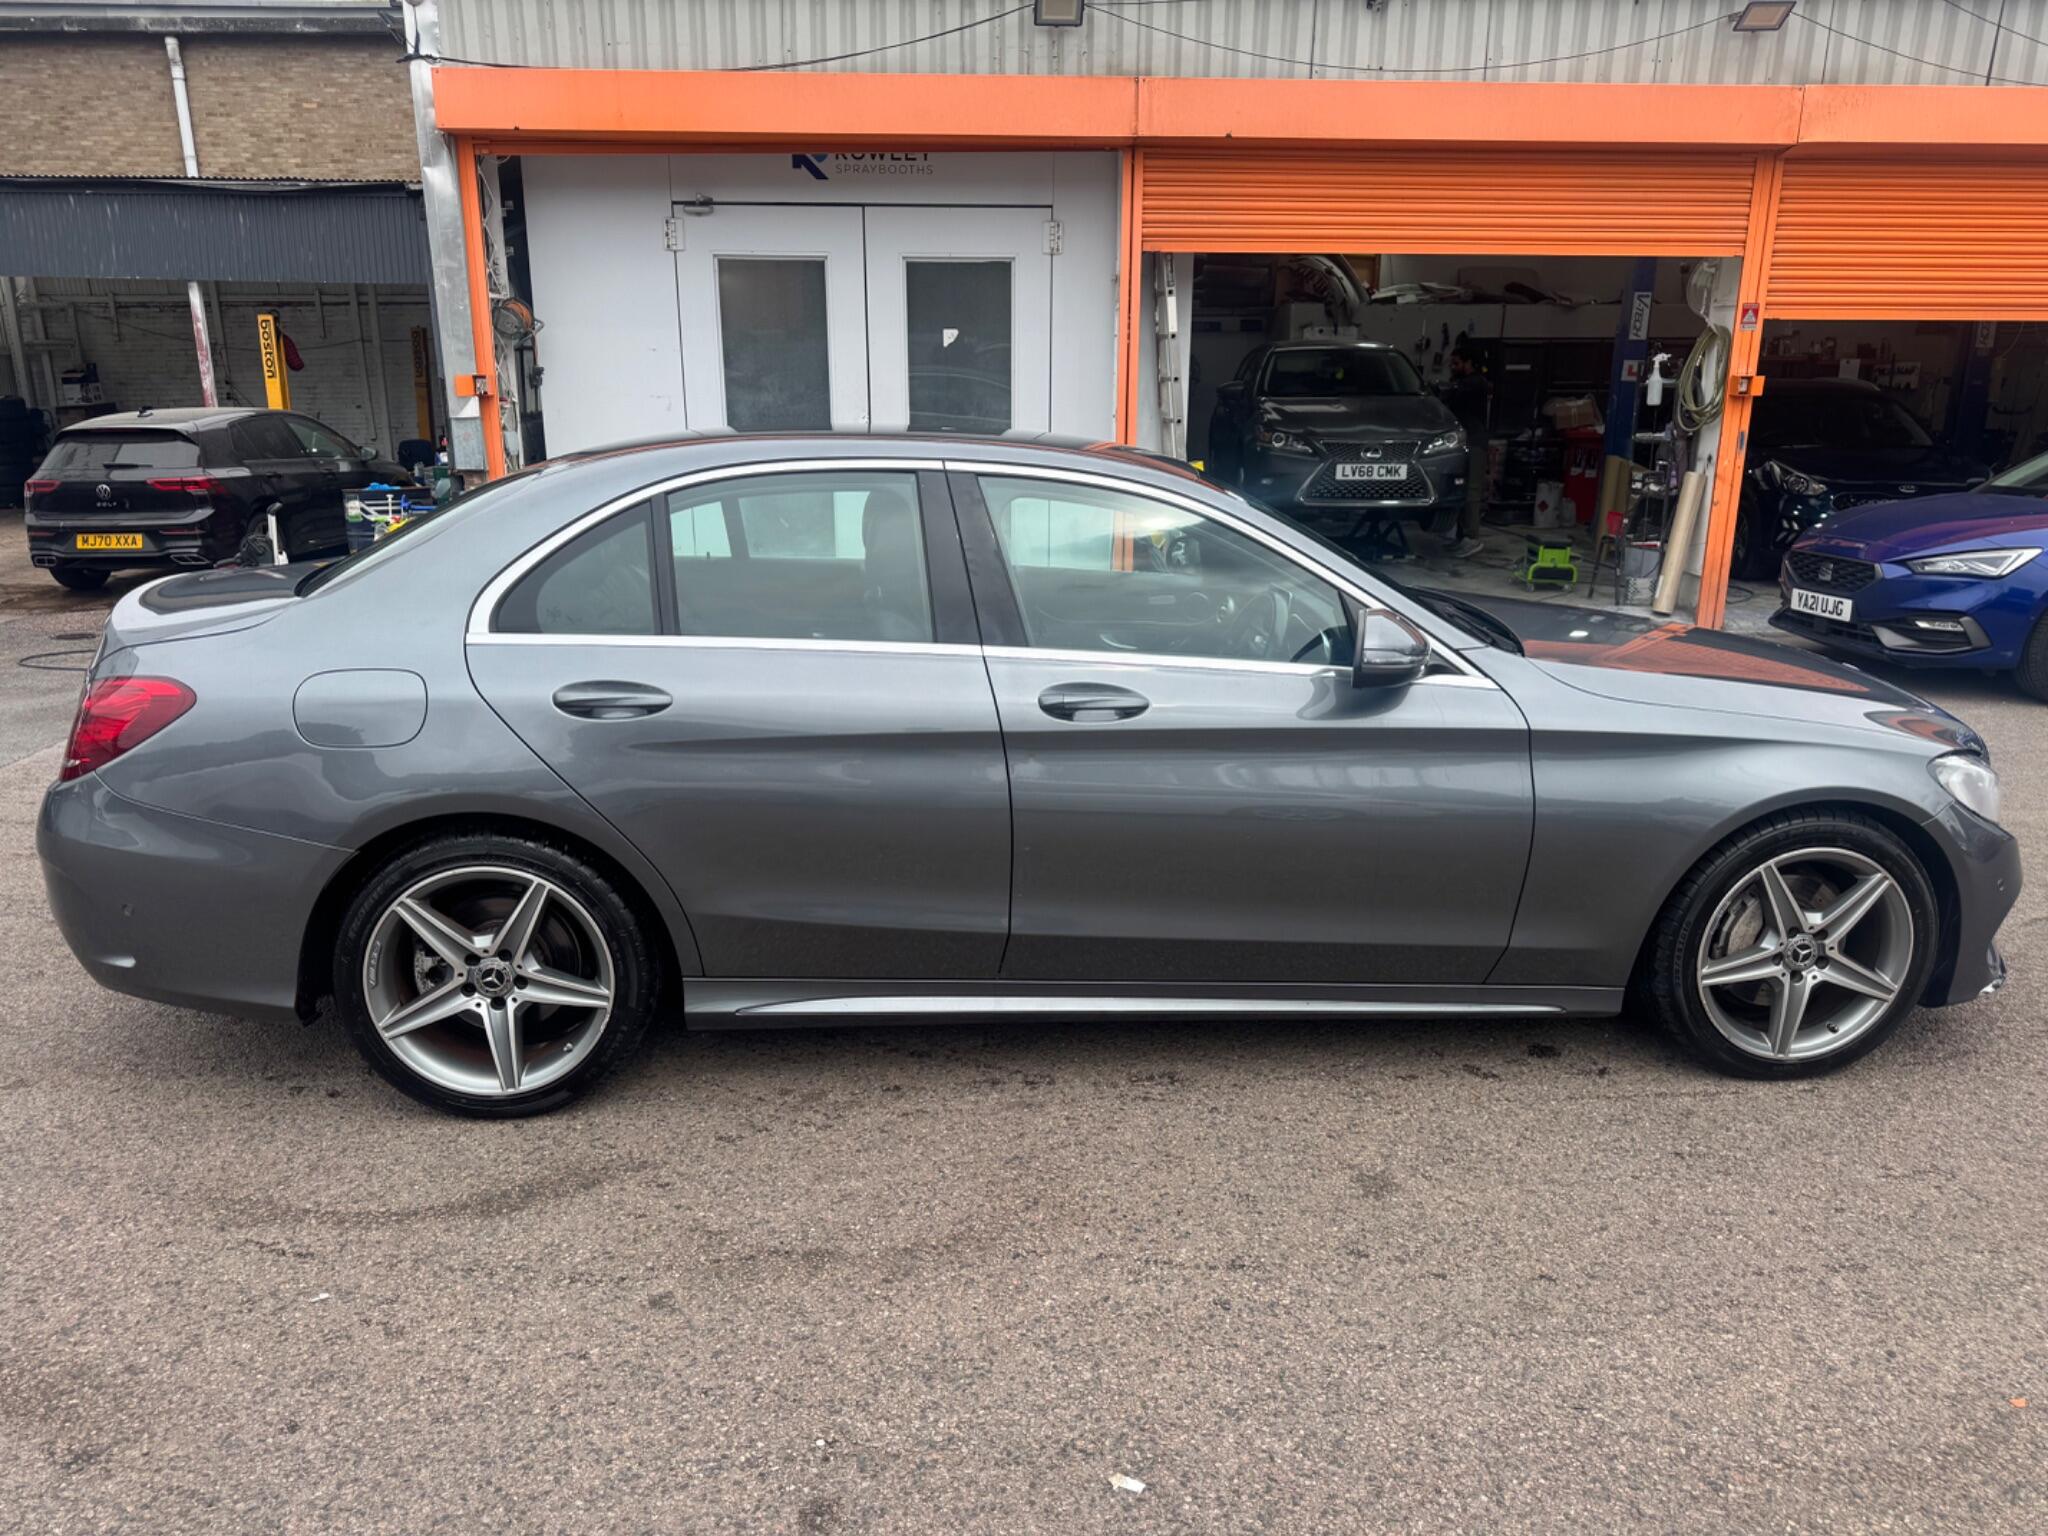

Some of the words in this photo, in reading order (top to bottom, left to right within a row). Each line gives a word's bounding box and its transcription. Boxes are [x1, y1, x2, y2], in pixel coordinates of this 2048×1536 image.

[835, 164, 934, 175] SPRAYBOOTHS
[1633, 293, 1651, 338] V-TECH
[260, 319, 276, 379] boston
[1341, 465, 1374, 478] LV68
[1377, 465, 1402, 478] CMK
[81, 535, 112, 547] MJ70
[115, 535, 138, 547] XXA
[1797, 591, 1820, 613] YA21
[1820, 596, 1844, 617] UJG
